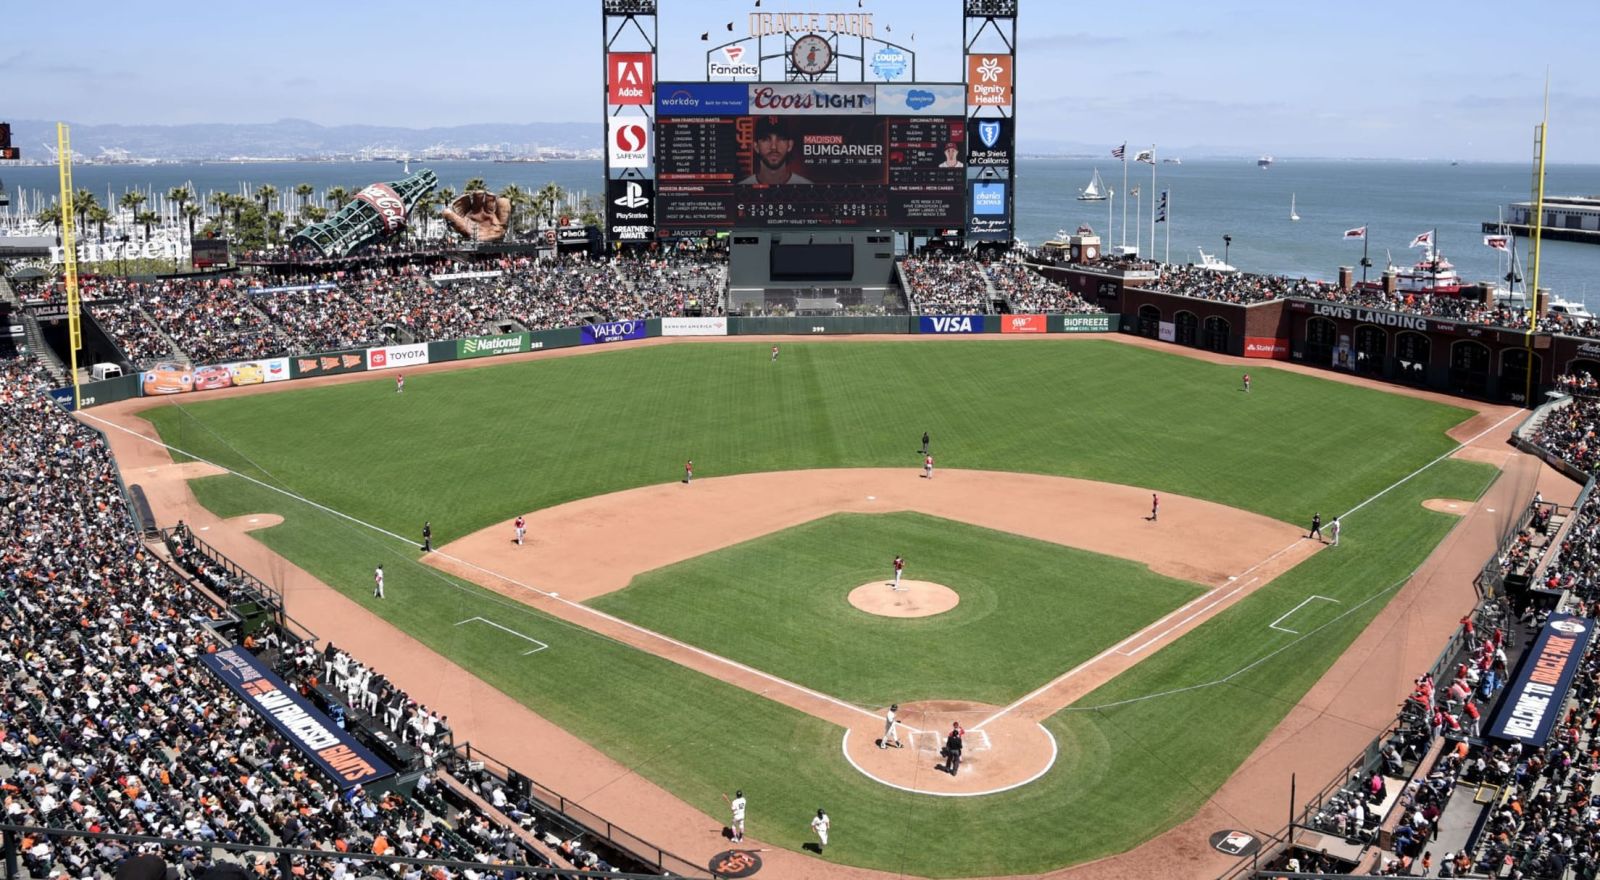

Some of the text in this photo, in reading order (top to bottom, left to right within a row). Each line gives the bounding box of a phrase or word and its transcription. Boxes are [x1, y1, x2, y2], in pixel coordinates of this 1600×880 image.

[749, 13, 874, 40] ORACLE PARK
[876, 54, 903, 63] coupa
[710, 64, 758, 74] Fanatics
[618, 88, 643, 96] Adobe
[974, 84, 1005, 95] Dignity
[662, 98, 699, 106] workday
[754, 87, 865, 109] Coors LIGHT
[976, 96, 1005, 104] Health
[804, 136, 842, 144] MADISON
[804, 144, 882, 156] BUMGARNER
[50, 239, 184, 264] nuveen
[930, 317, 972, 332] VISA
[1356, 309, 1427, 330] LANDING
[592, 322, 636, 338] YAHOO!
[477, 336, 522, 350] National
[390, 350, 425, 360] TOYOTA
[81, 397, 95, 405] 339
[1512, 394, 1525, 402] 309
[1503, 636, 1576, 738] WELCOME TO ORACLE PARK
[254, 690, 376, 780] SAN FRANCISCO GIANTS
